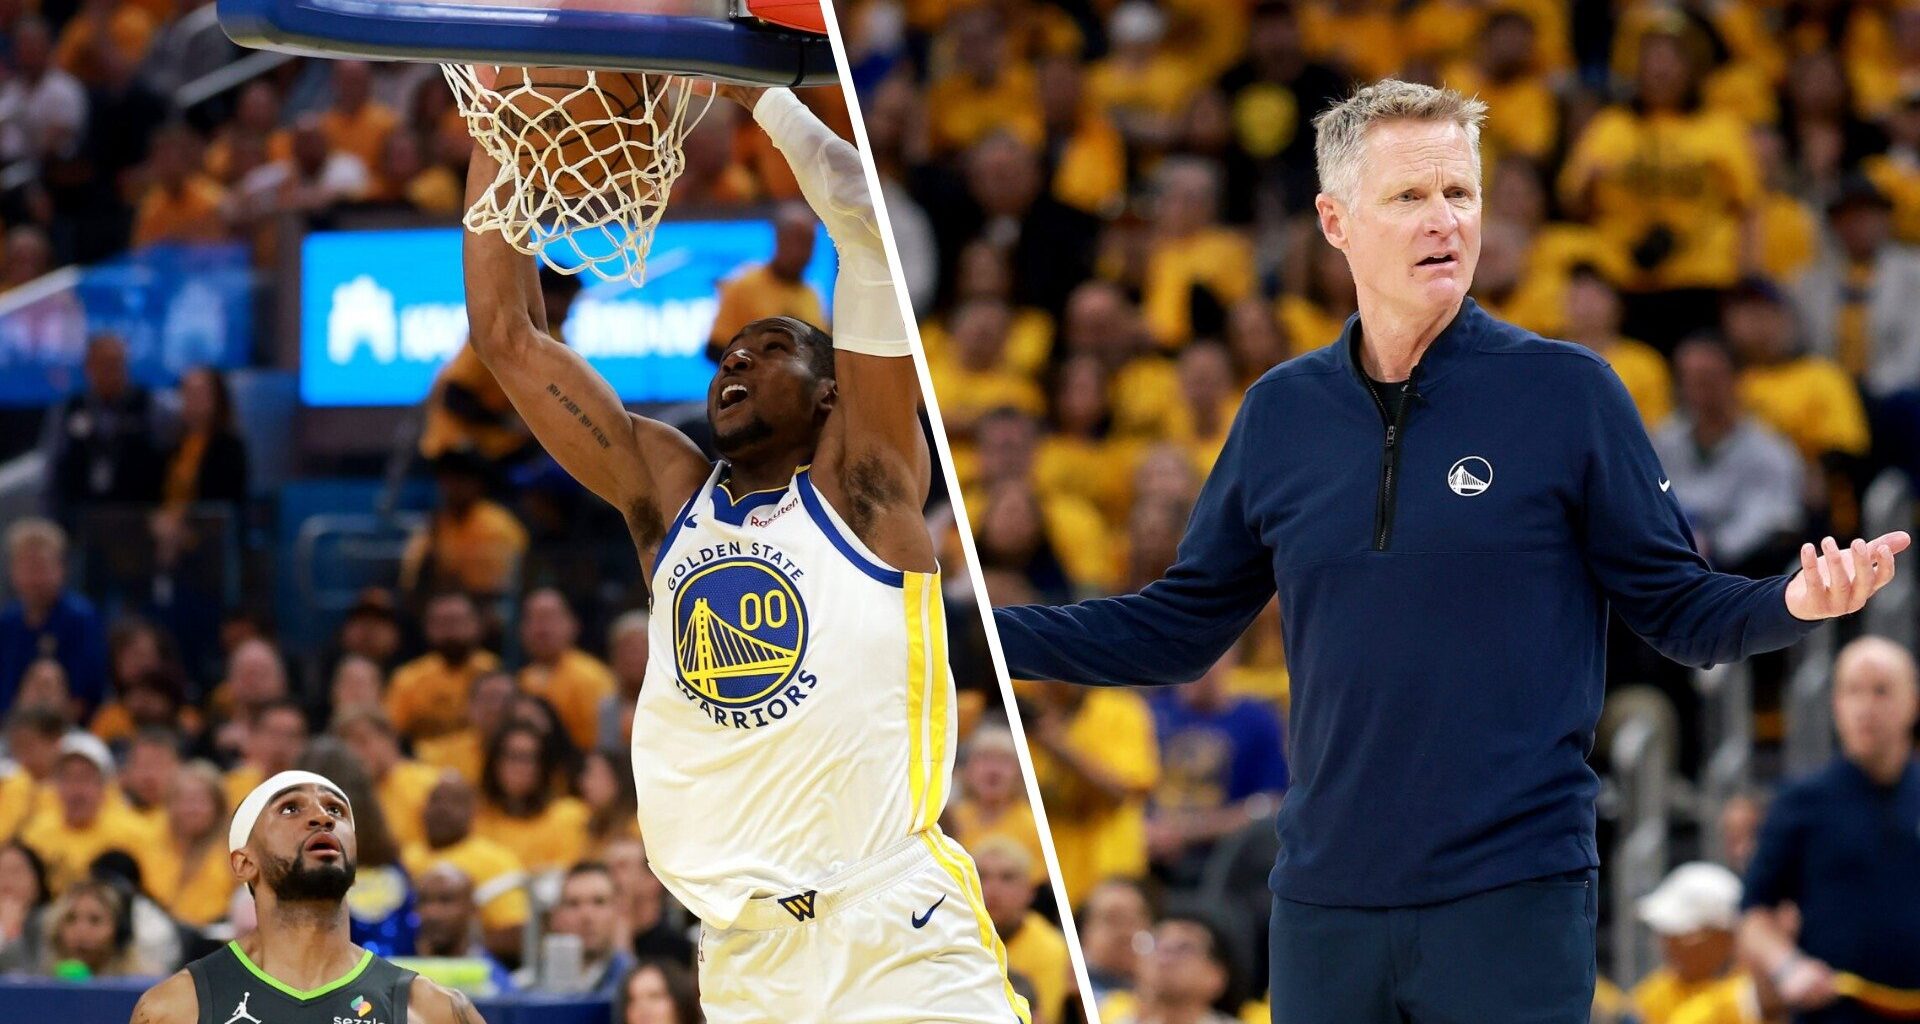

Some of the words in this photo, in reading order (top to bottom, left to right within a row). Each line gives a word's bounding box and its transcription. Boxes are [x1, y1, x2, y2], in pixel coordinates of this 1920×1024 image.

[668, 541, 741, 591] GOLDEN
[751, 542, 804, 582] STATE
[739, 589, 788, 631] 00
[333, 1016, 386, 1024] sezzl
